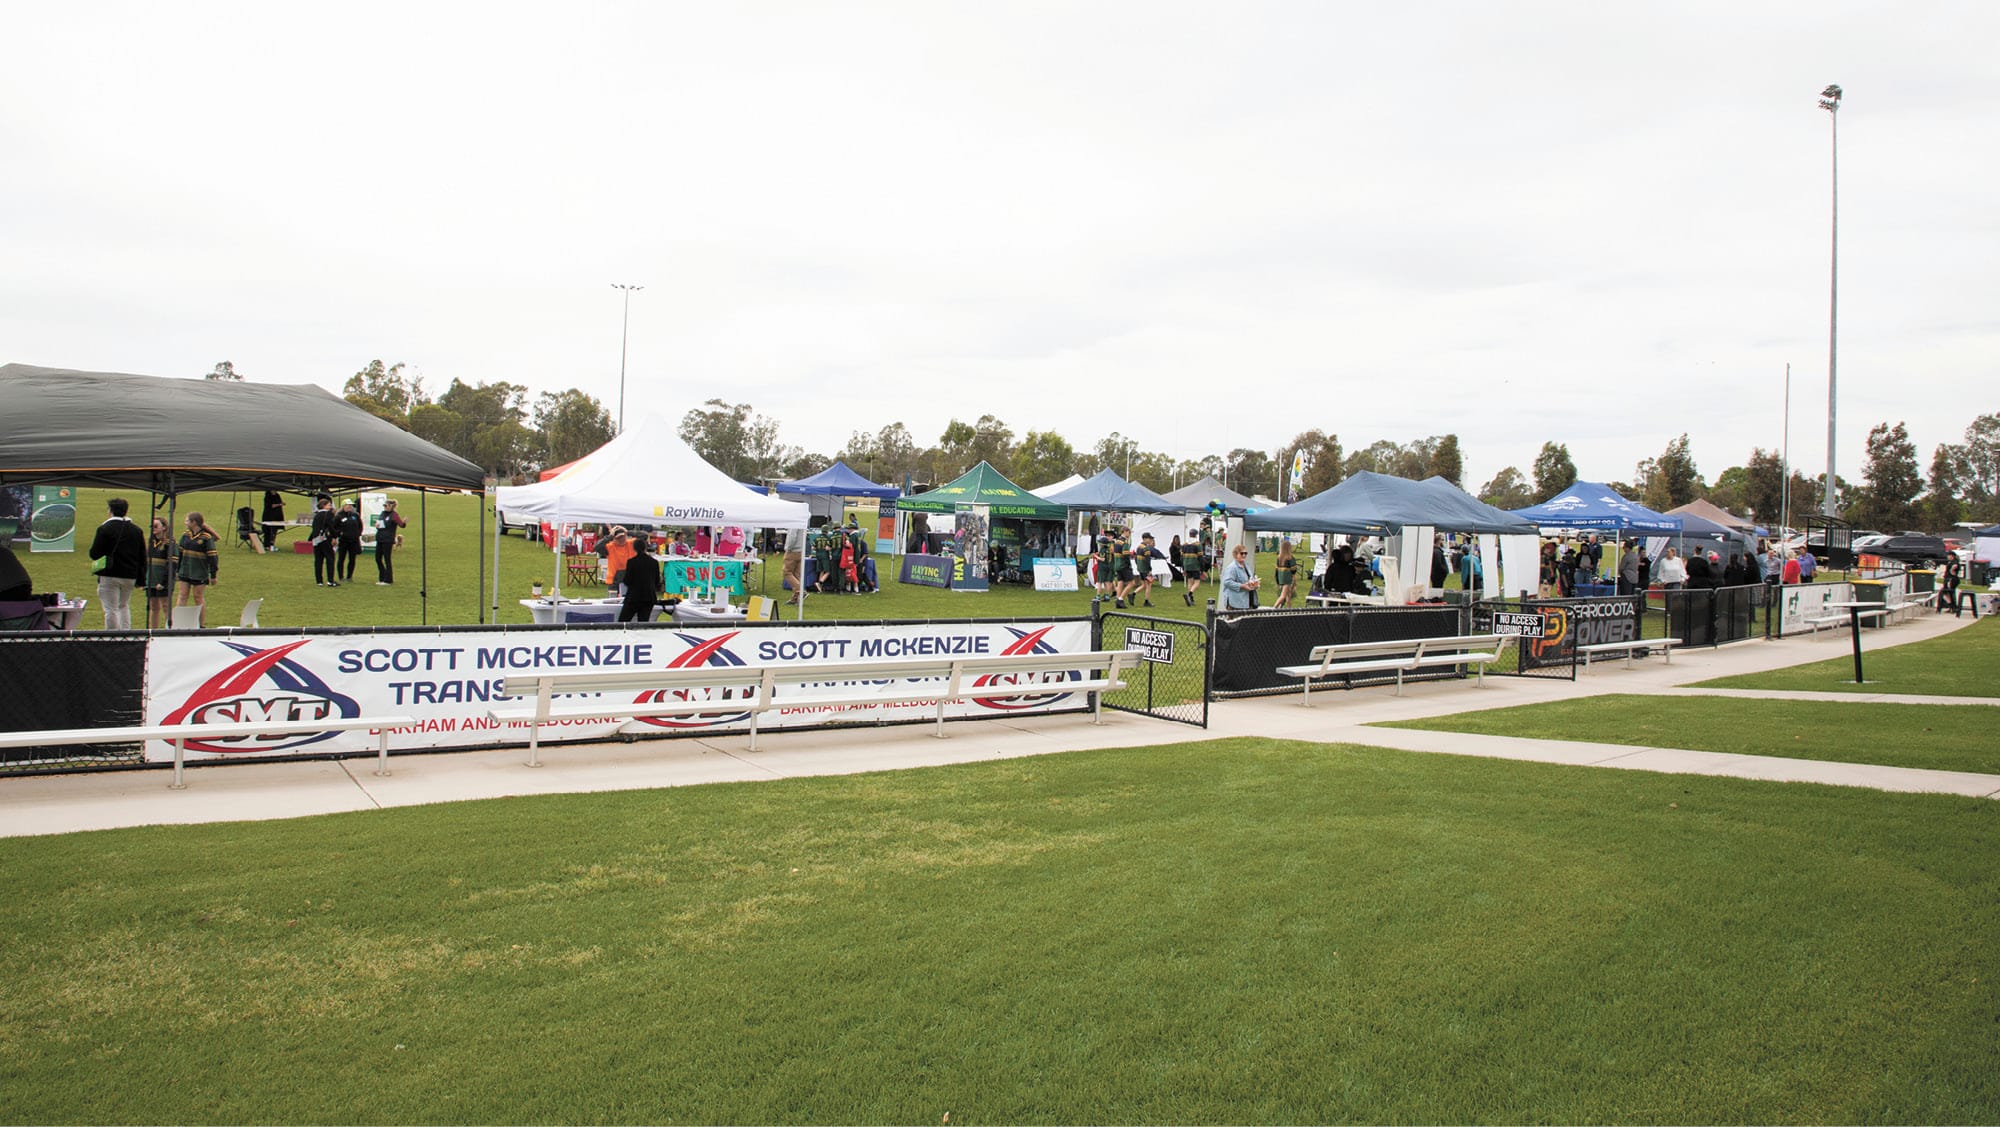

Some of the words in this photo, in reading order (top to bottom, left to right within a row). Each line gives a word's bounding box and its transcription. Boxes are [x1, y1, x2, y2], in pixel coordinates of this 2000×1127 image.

[999, 506, 1037, 515] EDUCATION
[953, 555, 964, 581] HAY
[1500, 614, 1510, 624] NO
[1510, 615, 1538, 626] ACCESS
[1496, 624, 1522, 635] DURING
[1523, 626, 1541, 636] PLAY
[1131, 631, 1141, 643] NO
[1141, 633, 1167, 647] ACCESS
[759, 640, 851, 660] SCOTT
[860, 636, 990, 657] MCKENZIE
[1152, 647, 1169, 659] PLAY
[338, 648, 465, 673] SCOTT
[477, 644, 653, 669] MCKENZIE
[389, 679, 602, 705] TRANS
[461, 716, 501, 731] AND
